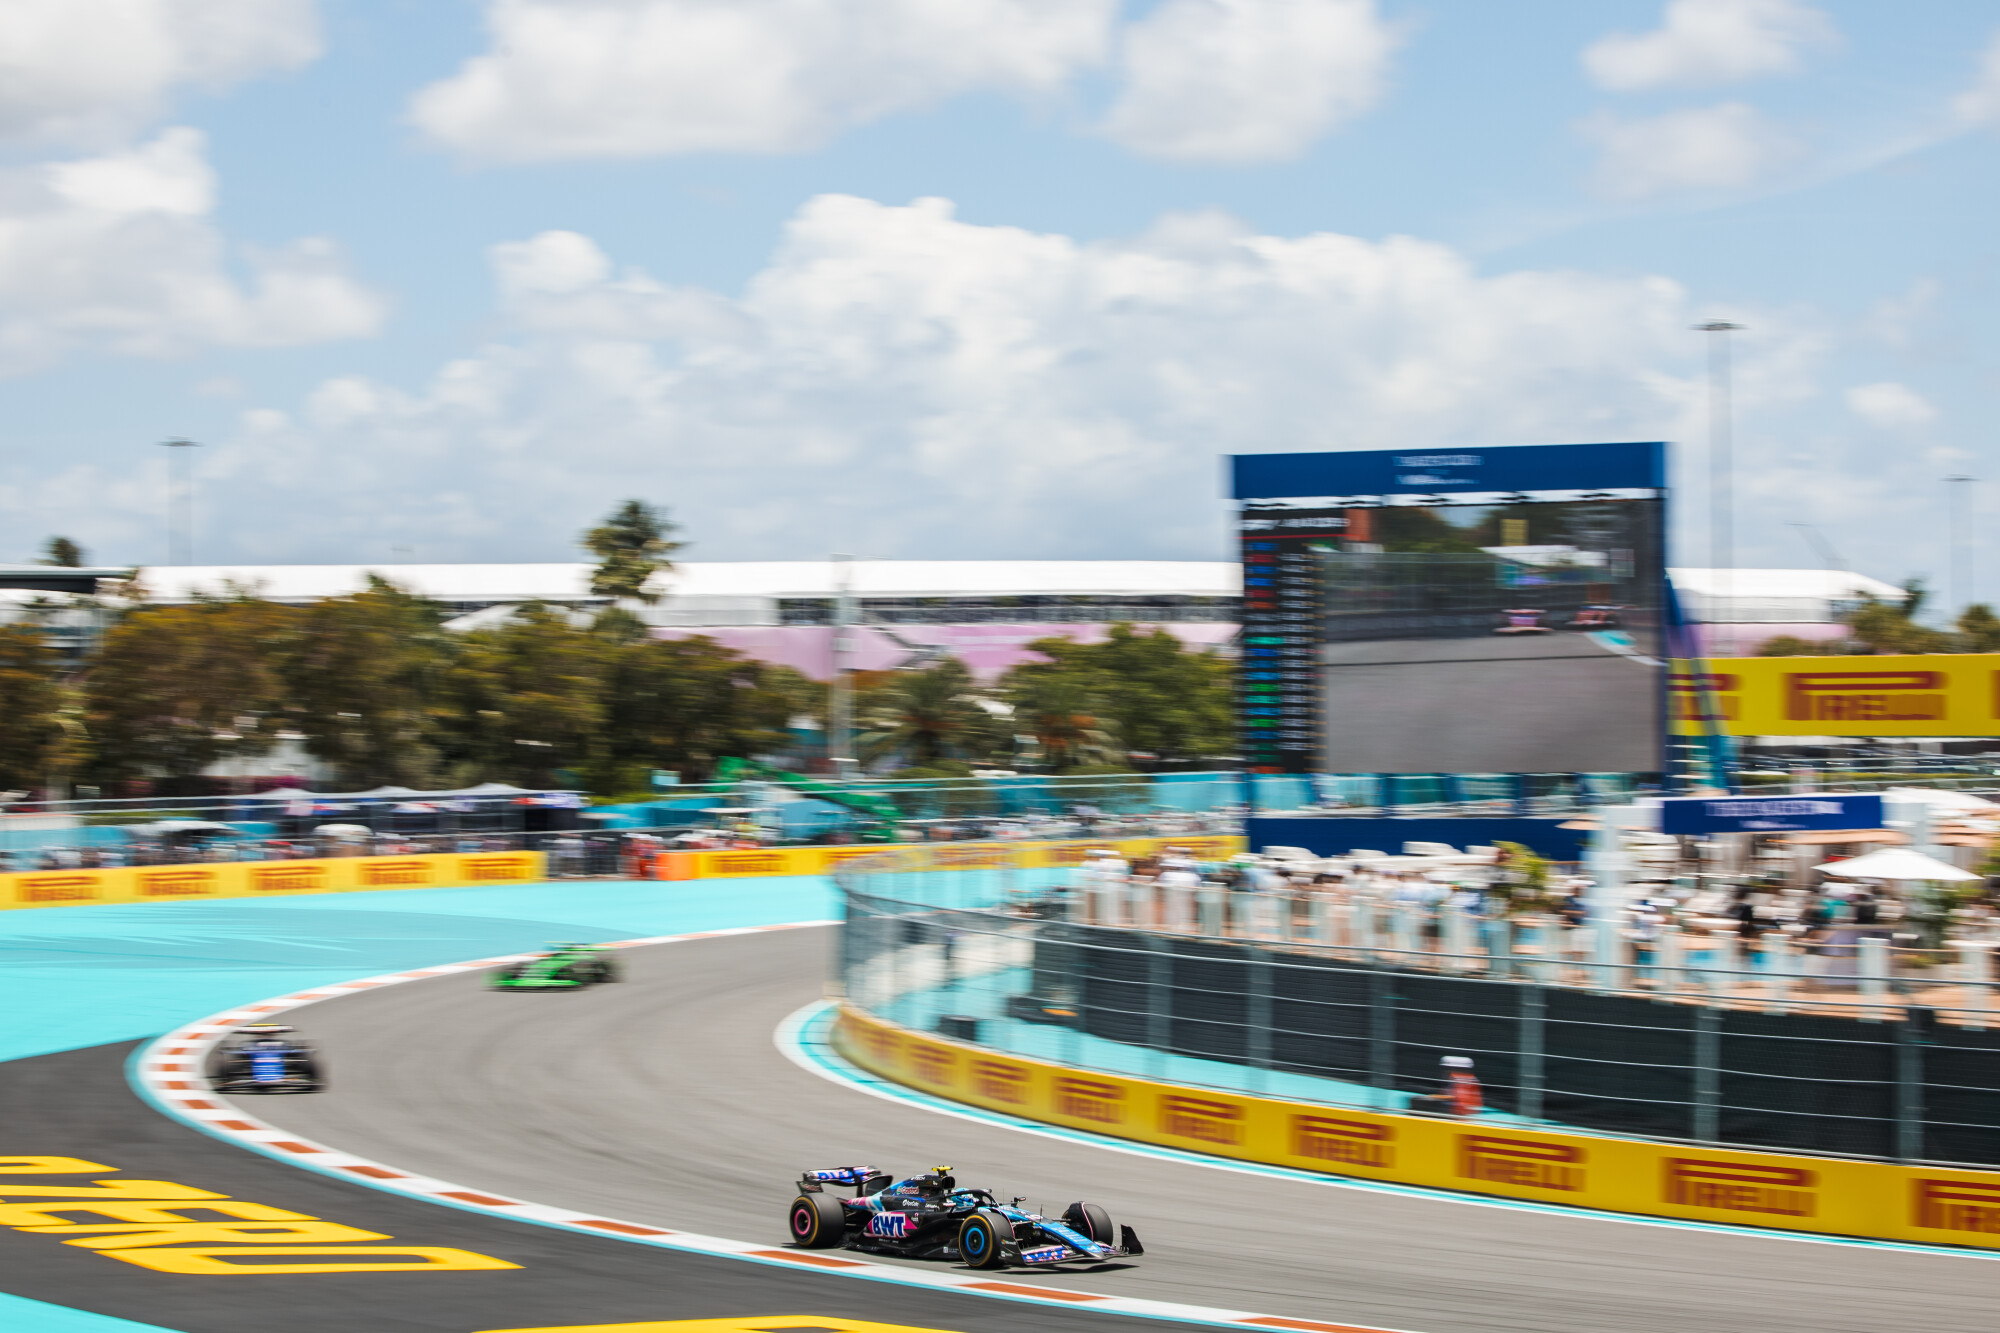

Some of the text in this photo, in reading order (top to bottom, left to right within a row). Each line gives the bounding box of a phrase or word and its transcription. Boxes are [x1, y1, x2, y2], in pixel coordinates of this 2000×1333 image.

[1783, 671, 1948, 720] PIRELLI
[1288, 1114, 1397, 1169] PIRELLI
[1454, 1133, 1589, 1192] PIRELLI
[1659, 1156, 1821, 1218] PIRELLI
[873, 1213, 906, 1237] BWT
